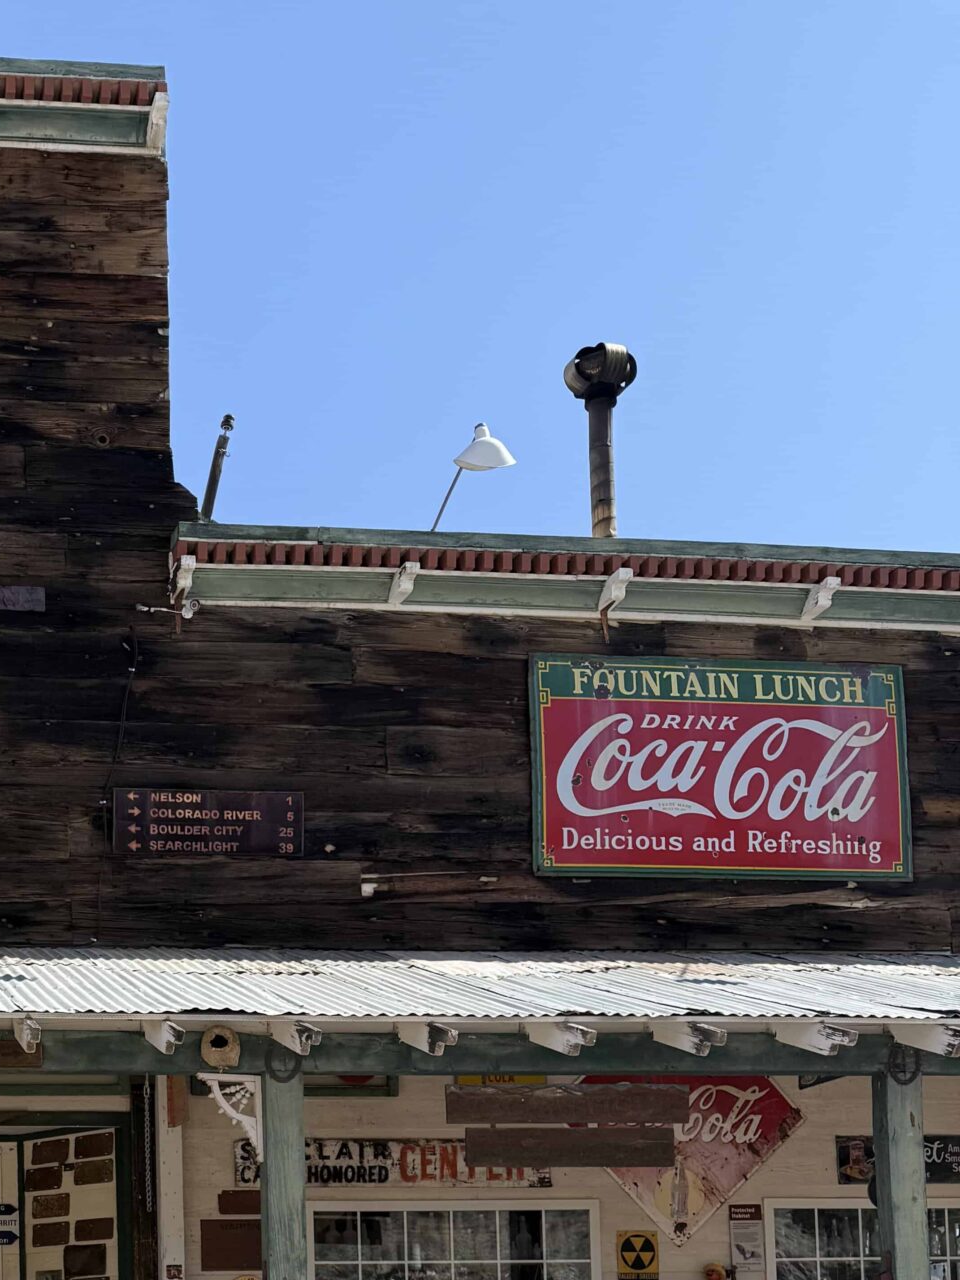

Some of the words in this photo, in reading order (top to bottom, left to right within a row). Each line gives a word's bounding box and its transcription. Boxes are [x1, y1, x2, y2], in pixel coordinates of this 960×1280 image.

[572, 667, 739, 699] FOUNTAIN
[754, 674, 865, 703] LUNCH
[640, 713, 740, 731] DRINK
[556, 712, 889, 823] Coca-Cola
[150, 793, 202, 804] NELSON
[286, 796, 293, 806] 1
[149, 808, 220, 819] COLORADO
[223, 810, 262, 821] RIVER
[286, 812, 294, 822] 5
[149, 824, 211, 836] BOULDER
[214, 825, 243, 836] CITY
[279, 827, 294, 838] 25
[149, 841, 240, 852] SEARCHLIGHT
[278, 842, 294, 854] 39
[561, 827, 683, 851] Delicious
[692, 830, 736, 853] and
[747, 830, 882, 863] Refreshing
[307, 1165, 389, 1184] HONORED
